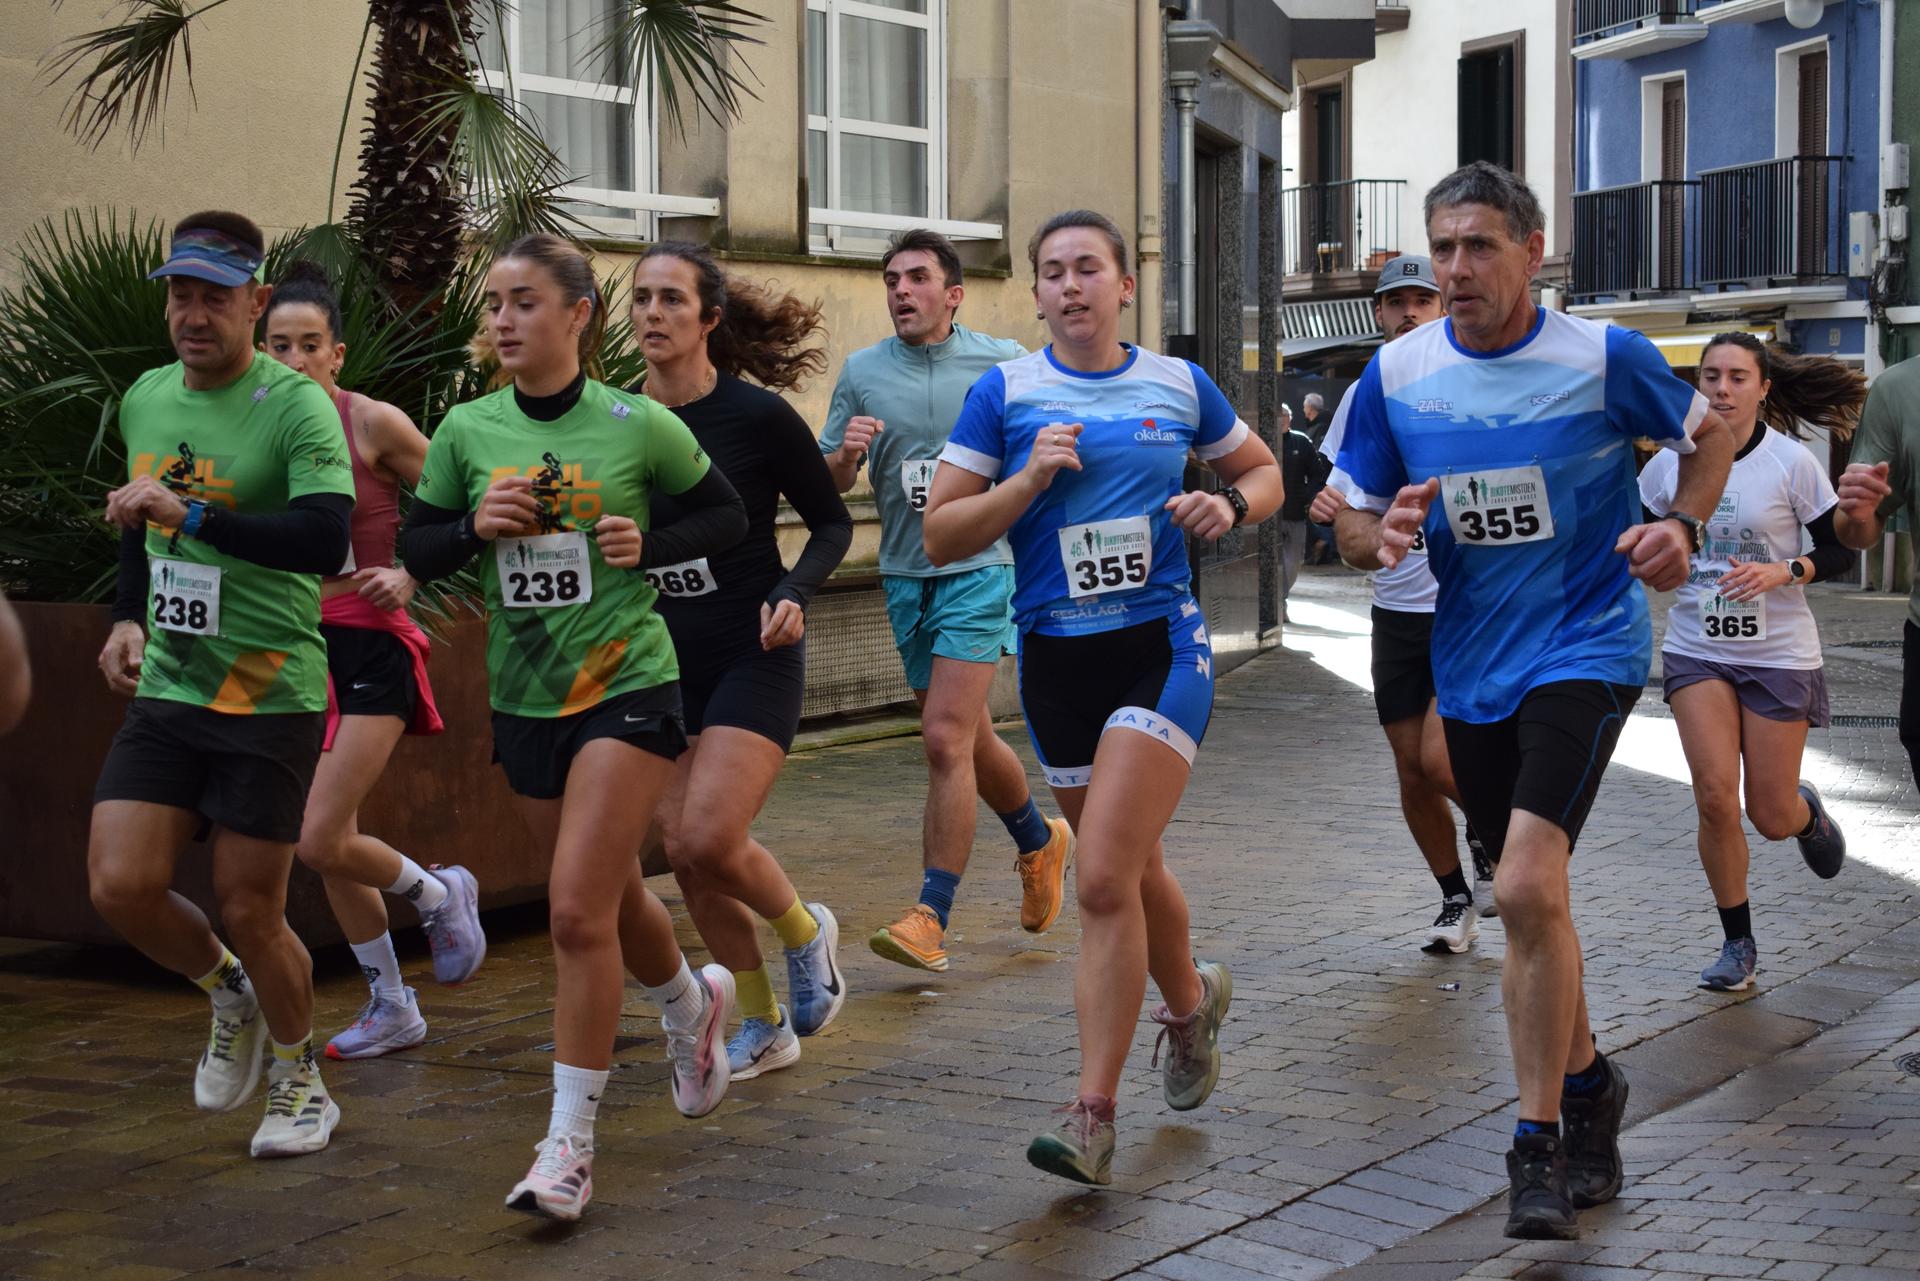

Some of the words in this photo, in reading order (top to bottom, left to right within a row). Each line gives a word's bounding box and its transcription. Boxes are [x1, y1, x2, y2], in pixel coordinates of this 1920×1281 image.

[1454, 490, 1469, 507] 46.
[1459, 504, 1540, 541] 355
[509, 569, 580, 602] 238
[645, 568, 706, 594] 268
[1075, 552, 1146, 590] 355
[154, 593, 208, 630] 238
[1705, 616, 1758, 637] 365
